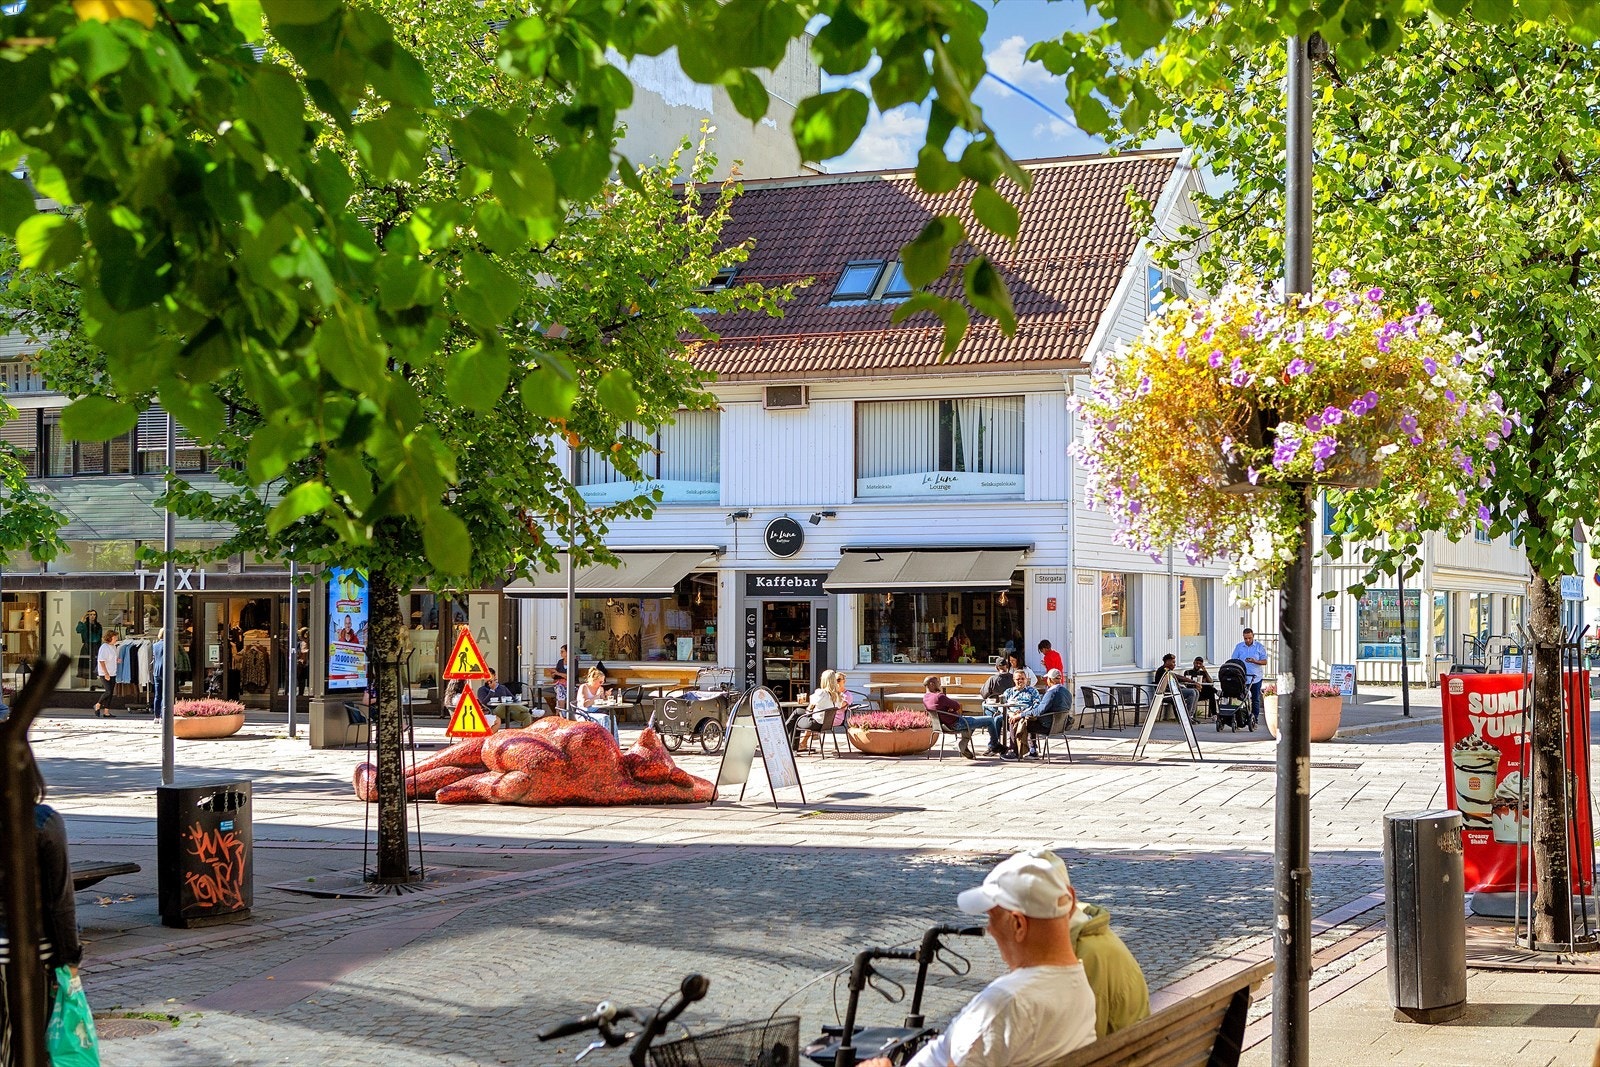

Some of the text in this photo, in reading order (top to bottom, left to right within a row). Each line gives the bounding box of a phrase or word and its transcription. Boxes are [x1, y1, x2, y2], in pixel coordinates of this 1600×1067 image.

[922, 473, 959, 485] La Luna
[633, 481, 665, 492] La Luna
[770, 530, 797, 539] La Luna
[134, 568, 206, 590] TAXI
[755, 576, 818, 587] Kaffebar
[52, 598, 64, 660] TAX
[1468, 688, 1569, 715] SUMM
